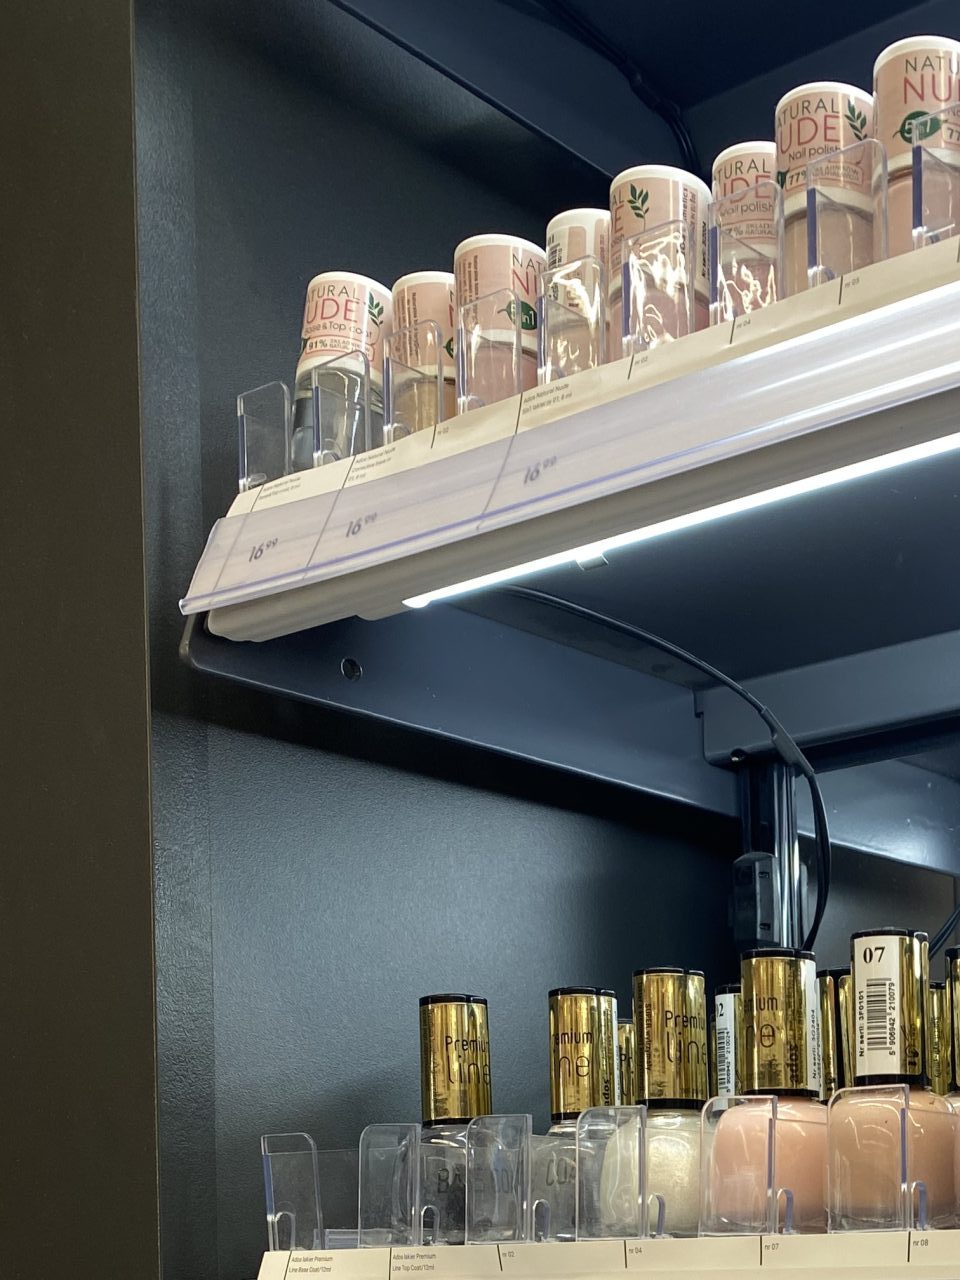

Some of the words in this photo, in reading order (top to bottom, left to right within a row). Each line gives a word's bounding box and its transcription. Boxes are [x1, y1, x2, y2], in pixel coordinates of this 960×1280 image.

[788, 147, 807, 161] Nail
[740, 199, 775, 216] polish
[329, 321, 347, 332] Top
[308, 339, 328, 351] 91%
[862, 946, 886, 964] 07
[888, 981, 896, 1011] 210079
[715, 1002, 725, 1018] 2
[888, 1017, 896, 1050] 906942
[858, 1046, 864, 1057] Nr
[770, 1242, 780, 1250] 07
[919, 1238, 929, 1246] 08
[634, 1246, 642, 1254] 04
[416, 1252, 437, 1260] Premium
[402, 1264, 410, 1272] Top
